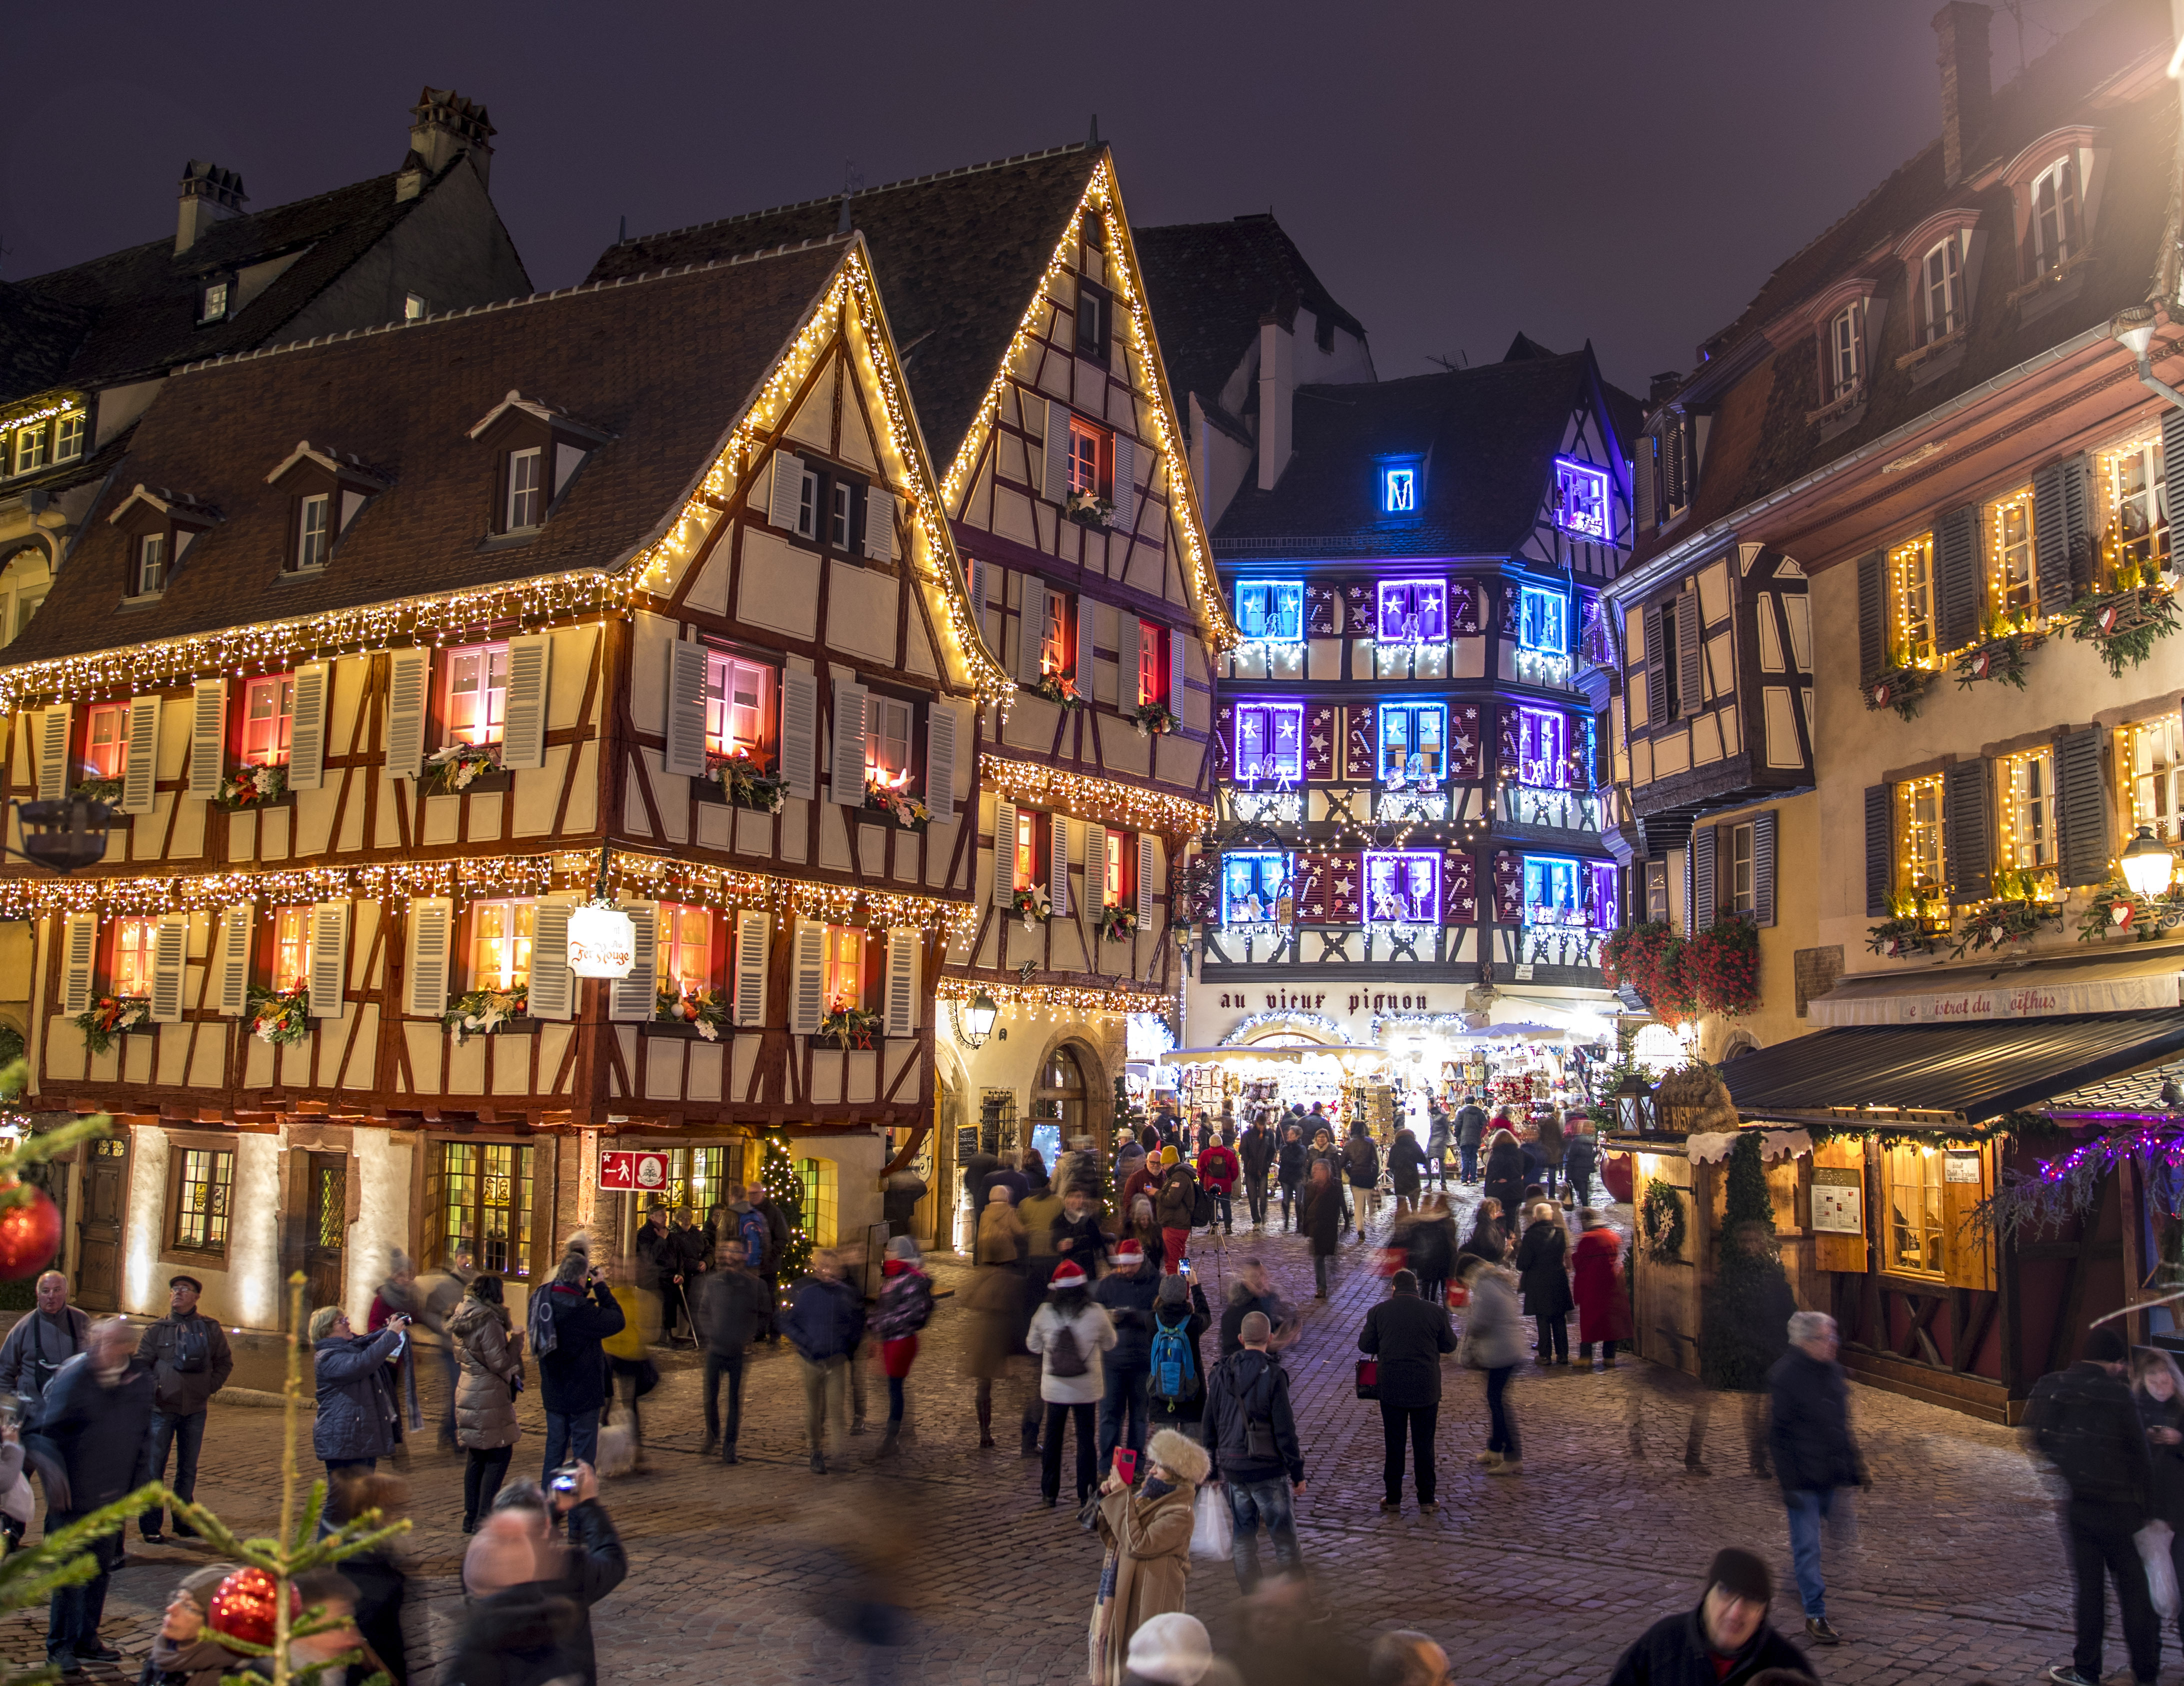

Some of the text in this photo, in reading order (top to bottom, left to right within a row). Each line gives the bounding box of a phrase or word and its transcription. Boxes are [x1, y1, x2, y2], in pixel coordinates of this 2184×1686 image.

[1220, 988, 1427, 1016] au vieux pignon
[1972, 994, 1990, 1013] du
[1672, 1106, 1706, 1132] BIST
